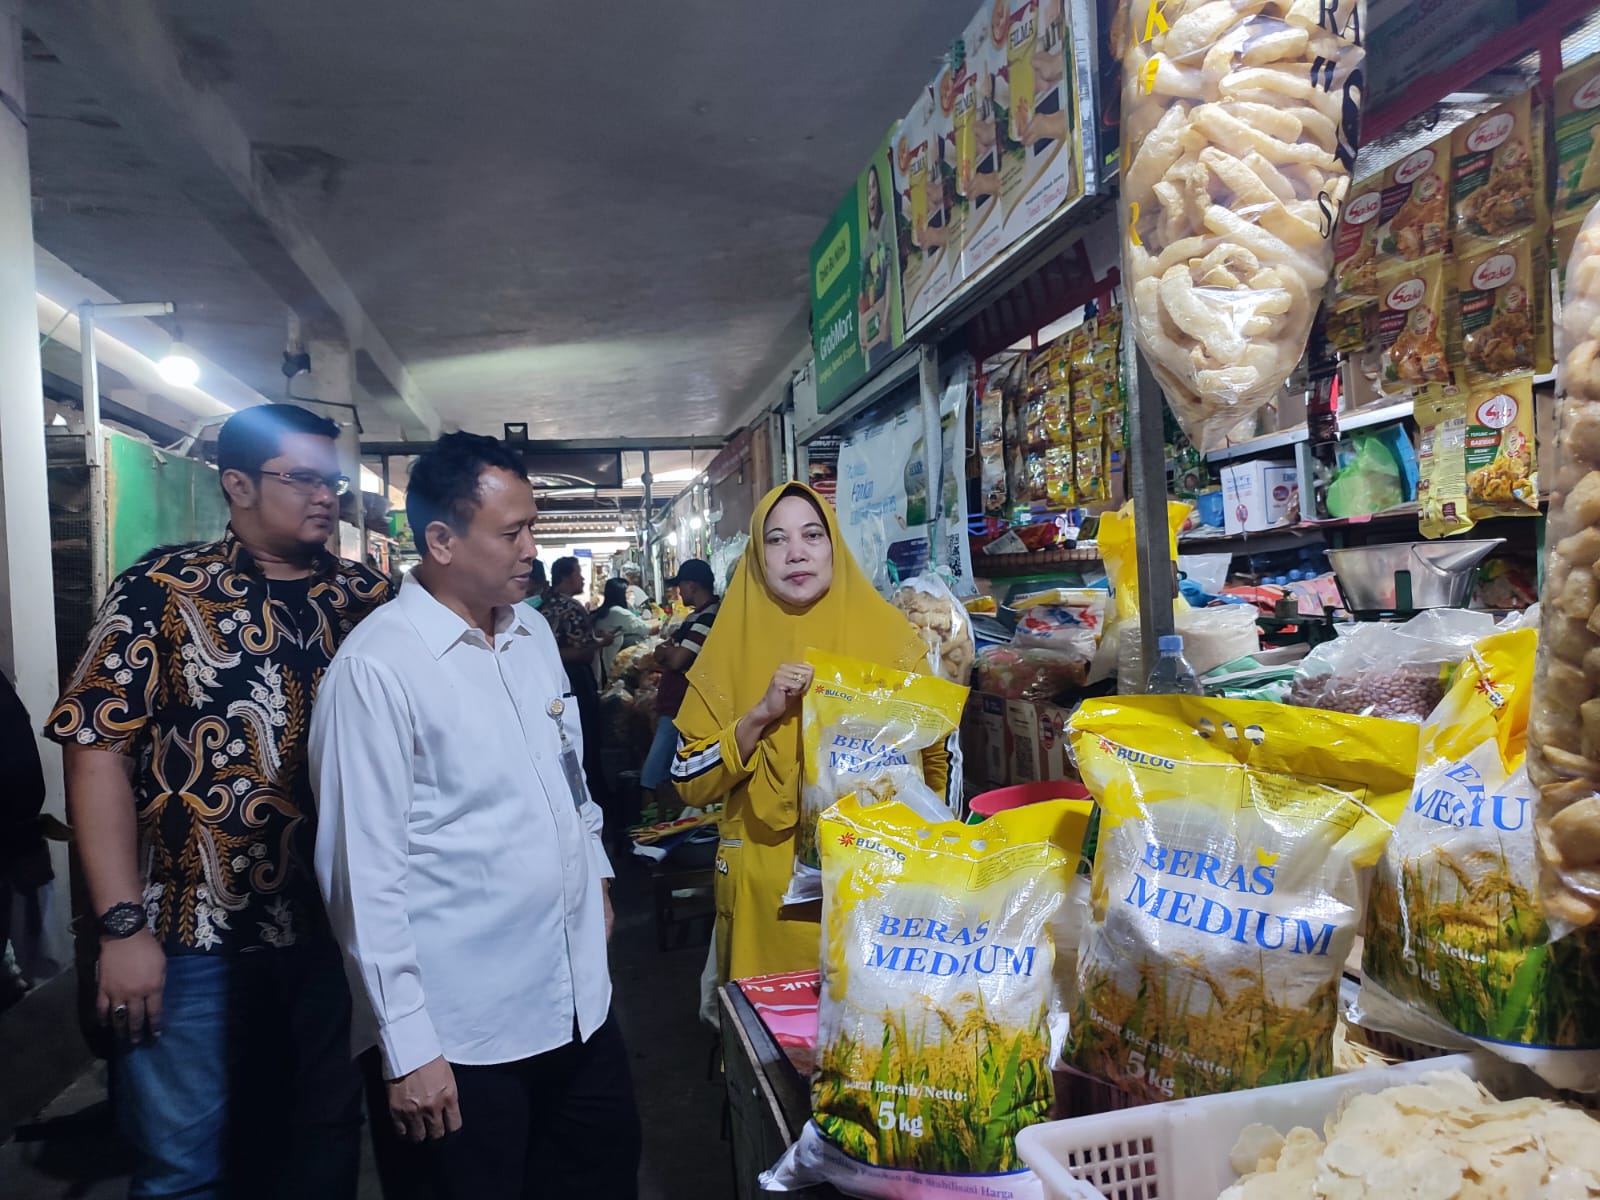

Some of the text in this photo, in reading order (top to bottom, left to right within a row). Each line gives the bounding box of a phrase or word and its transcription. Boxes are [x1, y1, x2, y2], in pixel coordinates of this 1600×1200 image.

[819, 310, 853, 361] GrabMart
[824, 689, 853, 702] BULOG
[829, 750, 910, 773] MEIUM
[1116, 747, 1176, 770] BULOG
[1414, 787, 1532, 832] MEDIU
[855, 837, 907, 862] BULOG
[1141, 841, 1277, 896] BERAS
[878, 913, 991, 947] BERAS
[1125, 873, 1338, 957] MEDIUM
[866, 942, 1037, 978] MEDIUM
[1126, 1050, 1176, 1097] 5 kg
[878, 1100, 924, 1138] 5 kg
